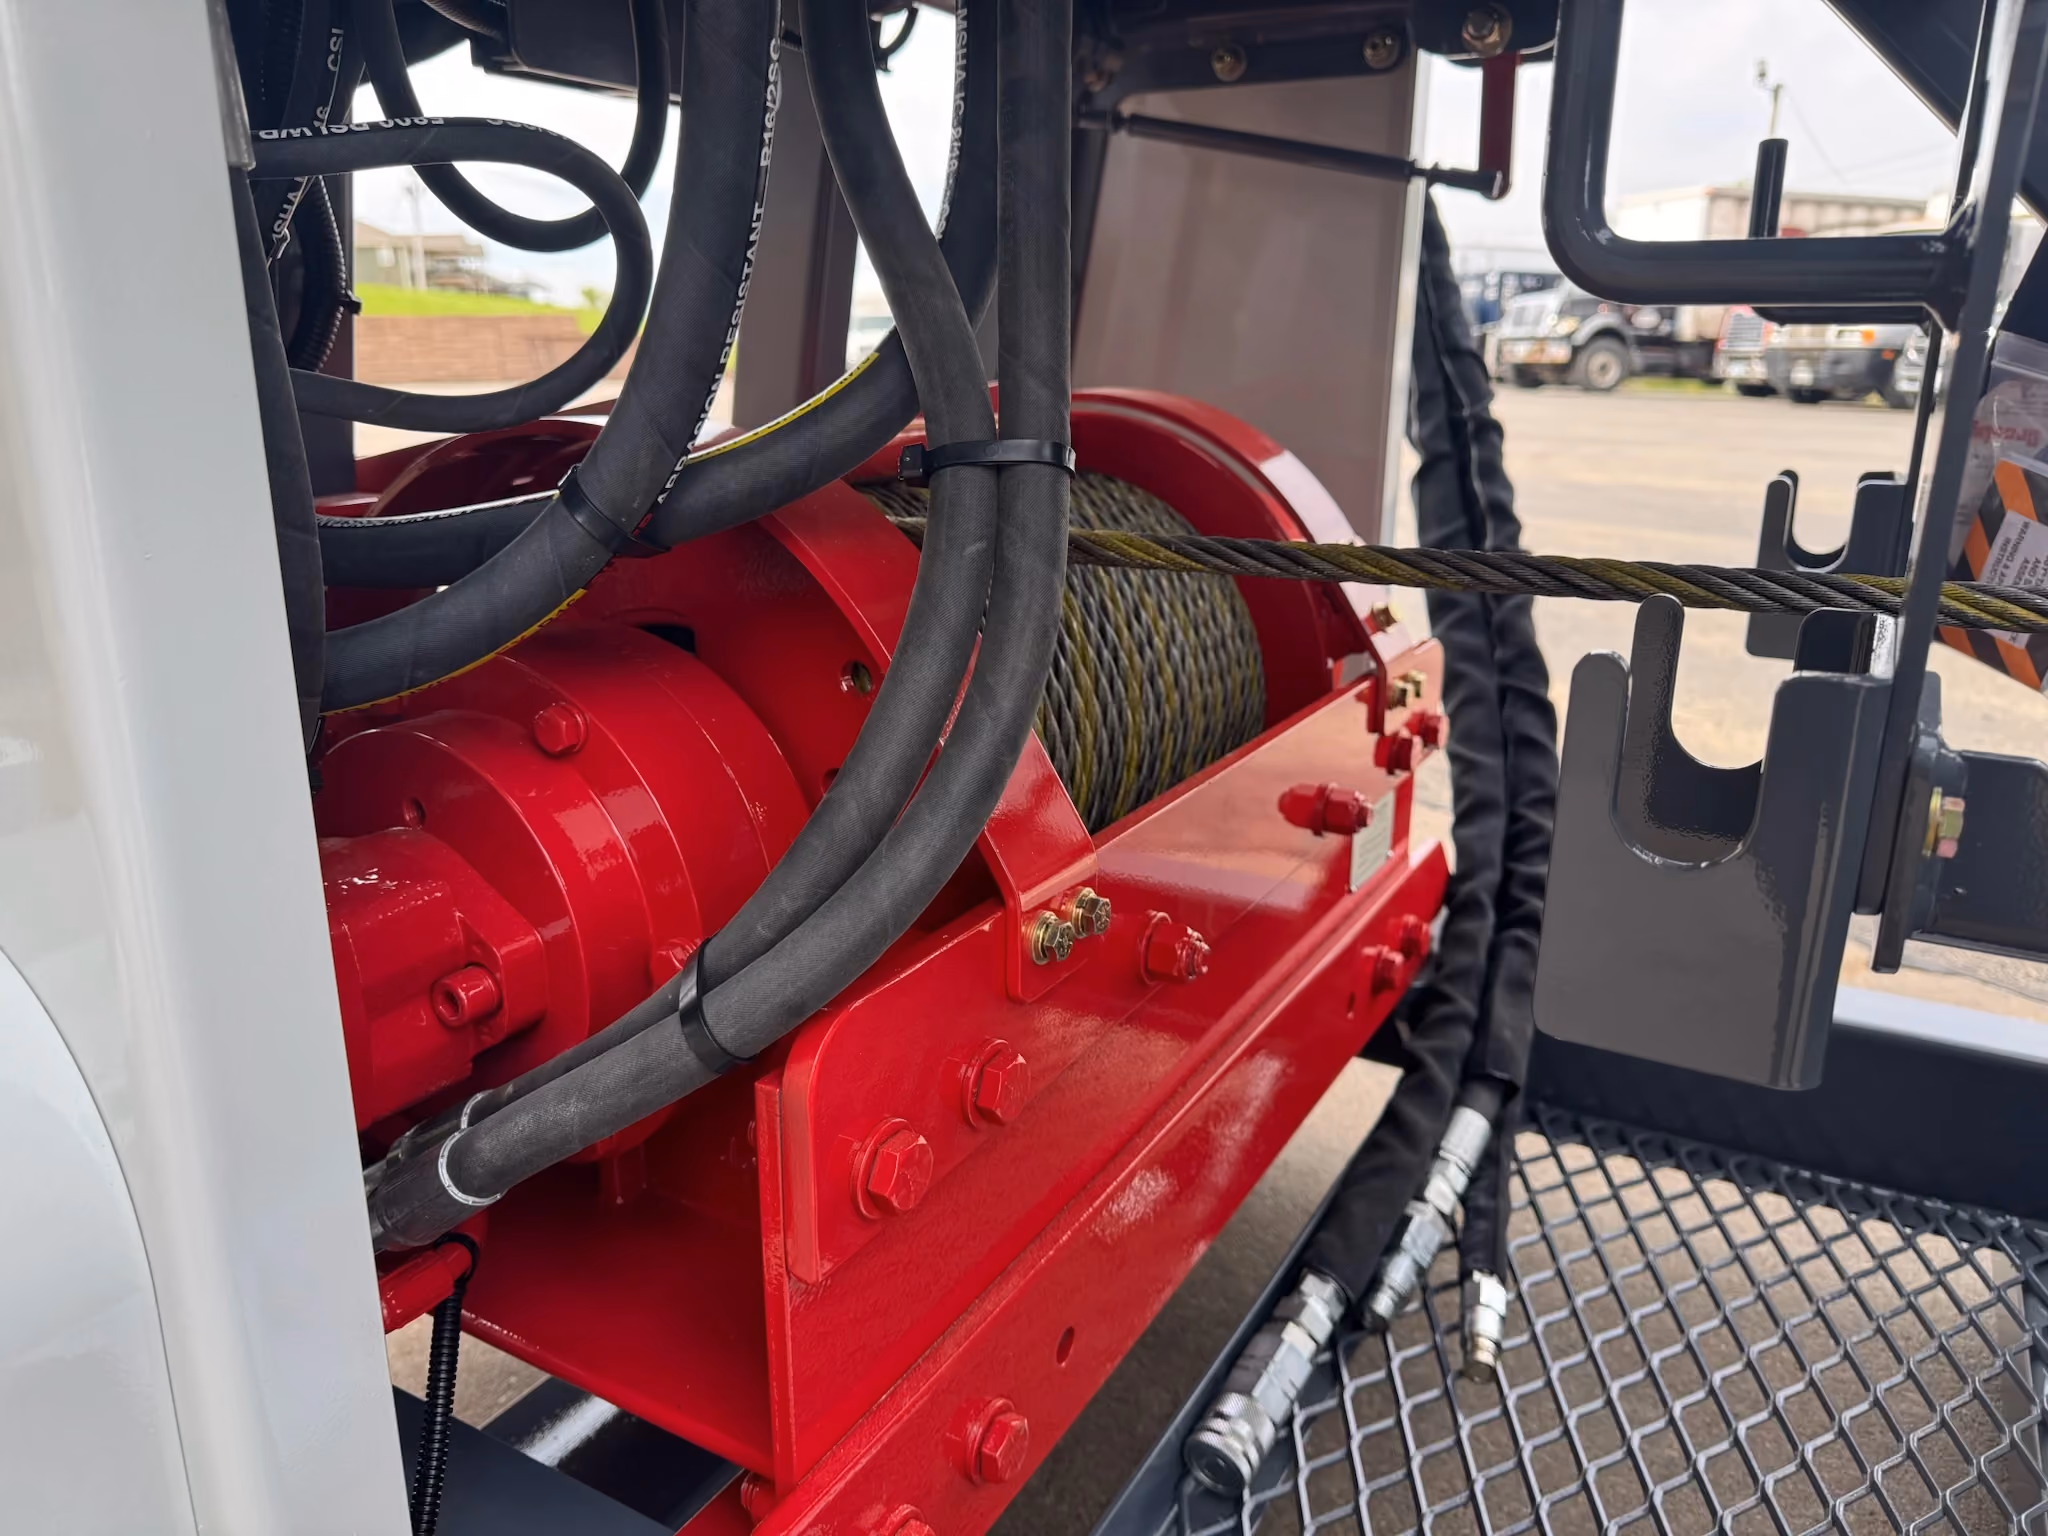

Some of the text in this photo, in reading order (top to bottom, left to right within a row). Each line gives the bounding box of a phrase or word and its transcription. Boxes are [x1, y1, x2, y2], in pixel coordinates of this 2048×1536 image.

[327, 28, 344, 72] CSI
[955, 8, 968, 85] MSHA
[1986, 536, 2012, 585] INSTRUCT
[2006, 521, 2030, 562] WARNING
